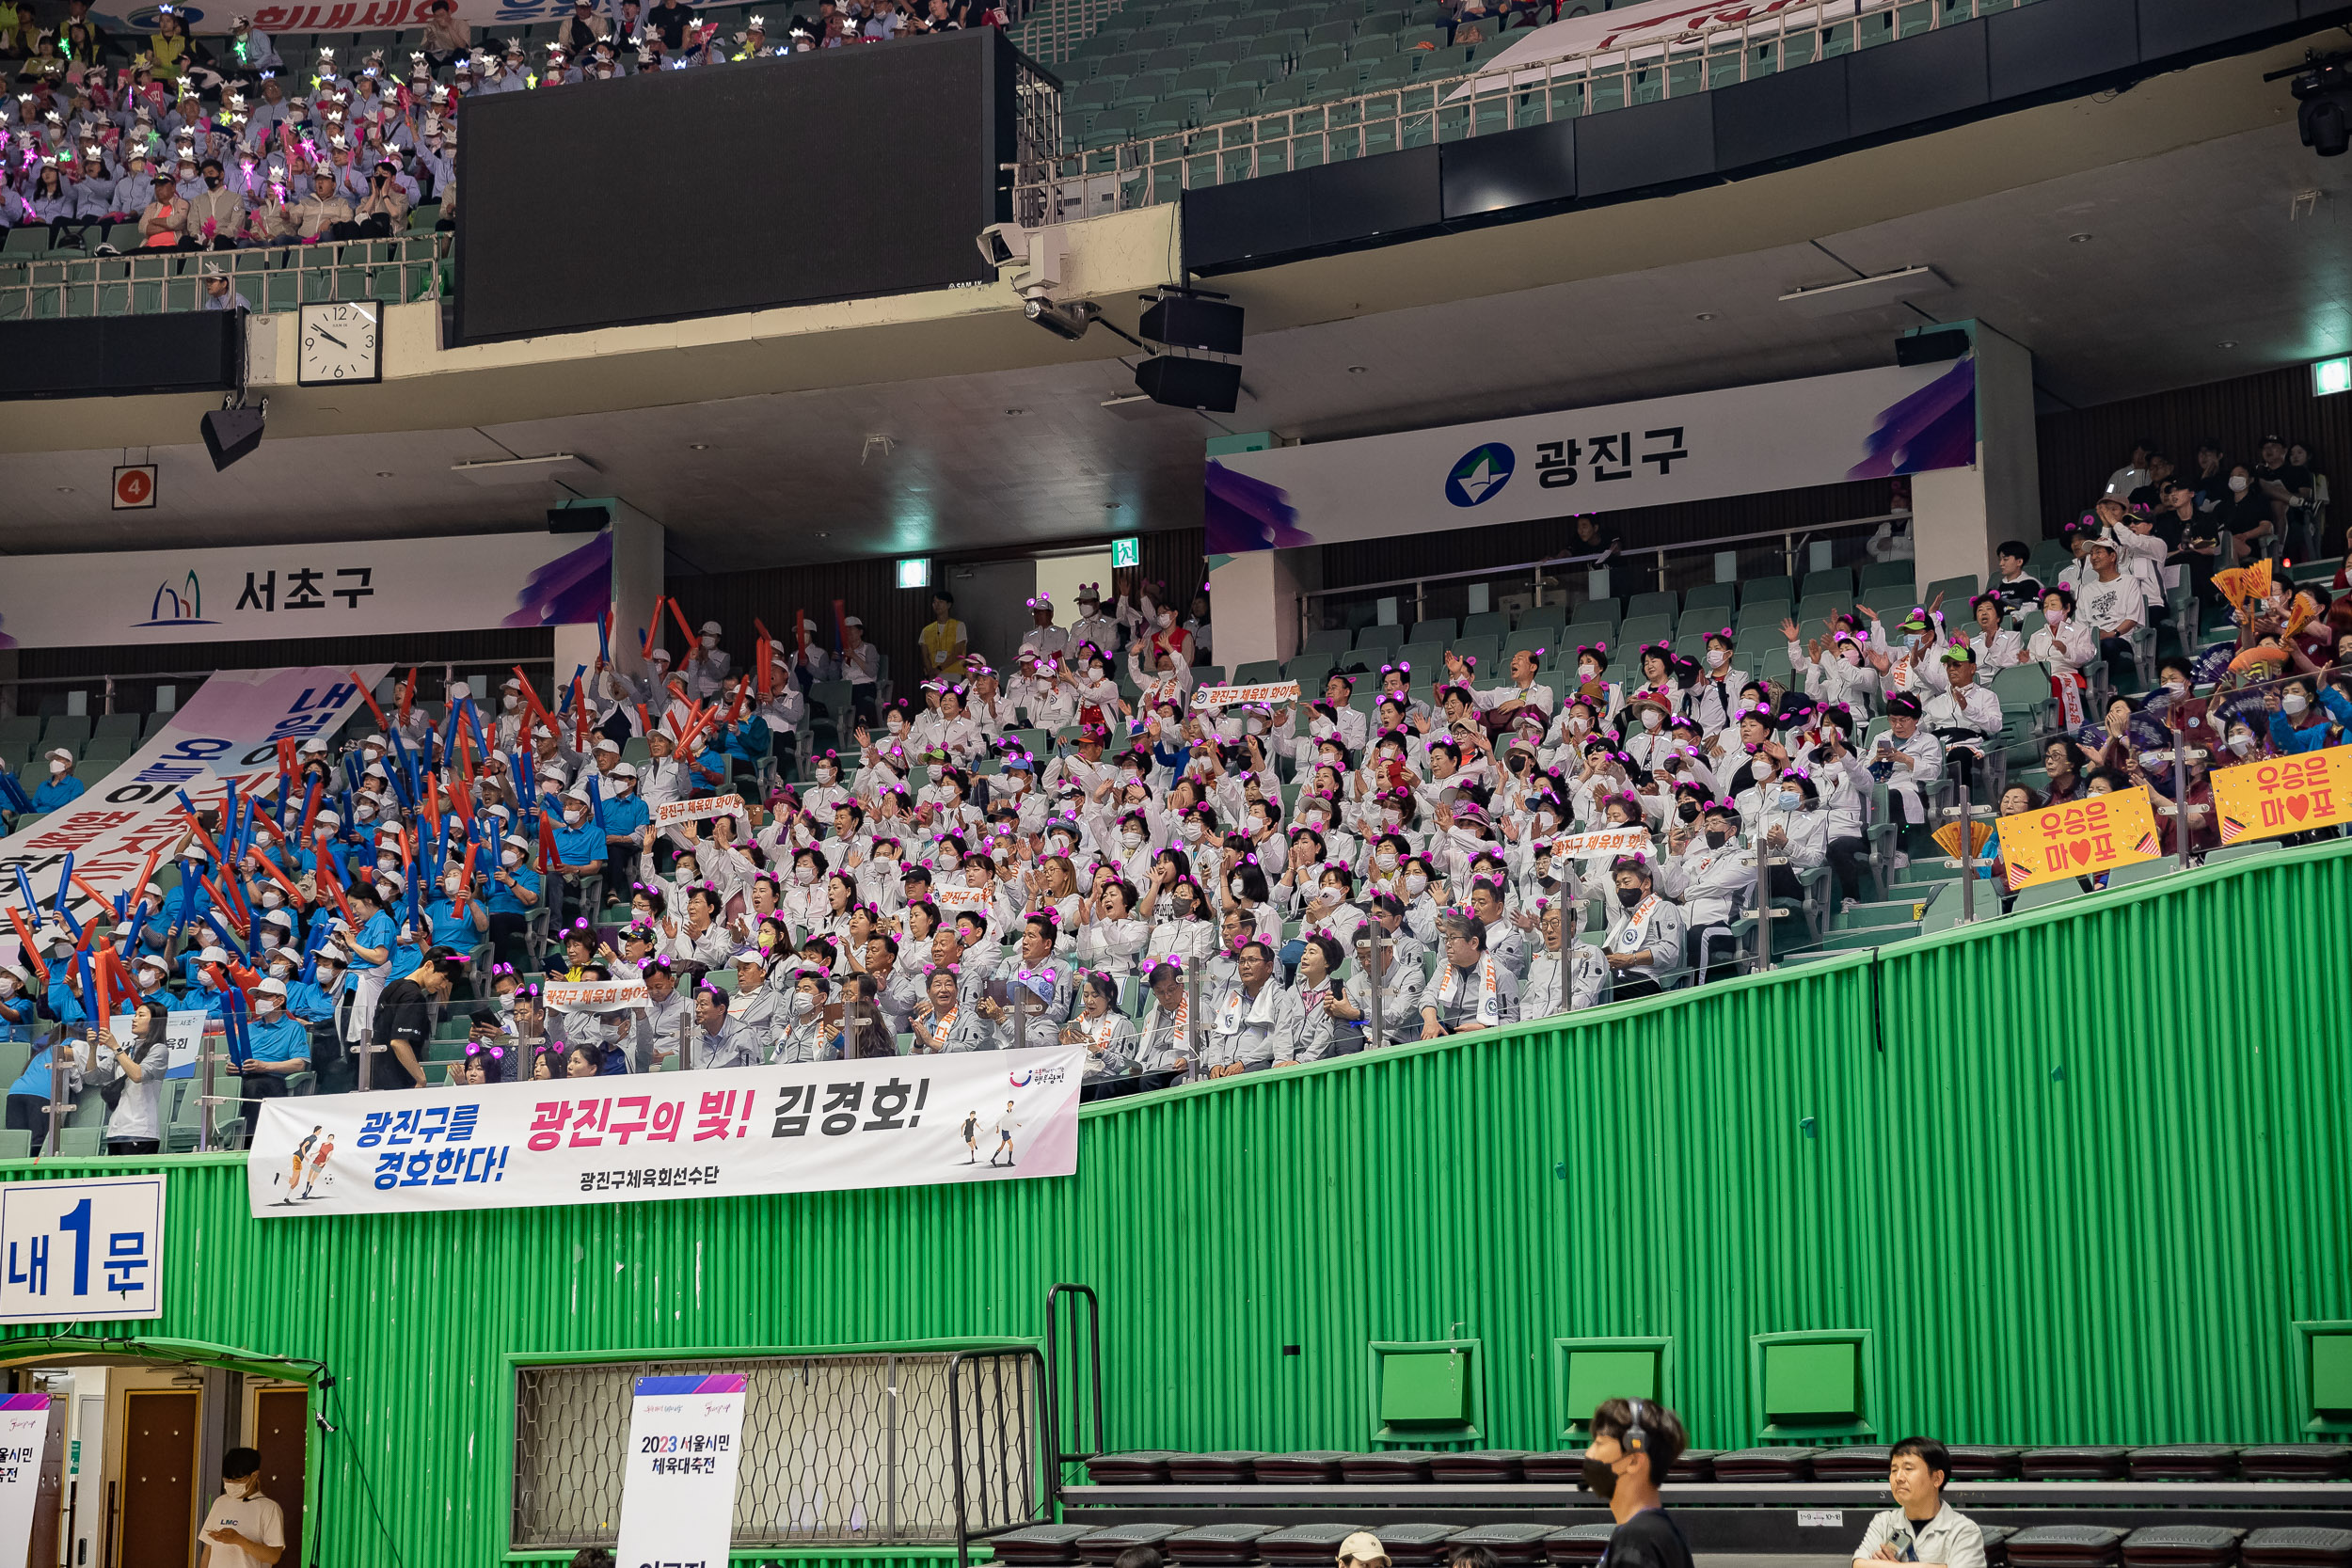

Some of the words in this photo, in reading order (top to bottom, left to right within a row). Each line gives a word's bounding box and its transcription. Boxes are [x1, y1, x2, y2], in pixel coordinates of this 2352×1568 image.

[332, 306, 347, 321] 12
[304, 337, 315, 351] 9
[365, 334, 374, 349] 3
[333, 364, 344, 378] 6
[1534, 426, 1689, 489] 광진구
[127, 478, 142, 496] 4
[234, 567, 374, 612] 서초구
[1210, 689, 1238, 705] 광진구
[1240, 687, 1269, 702] 체육회
[2256, 756, 2330, 795] 우승은
[660, 802, 686, 821] 광진구
[687, 798, 714, 814] 체육회
[2040, 801, 2110, 840] 우승은
[1585, 833, 1624, 850] 체육회
[580, 987, 618, 1005] 체육회
[527, 1095, 686, 1152] 광진구의
[692, 1089, 756, 1143] 빛!
[771, 1077, 930, 1139] 김경호!
[356, 1104, 481, 1148] 광진구를
[373, 1145, 511, 1191] 경호한다!
[580, 1165, 721, 1193] 광진구체육회선수단
[641, 1435, 678, 1454] 2023
[679, 1433, 731, 1453] 서울시민
[651, 1456, 716, 1476] 체육대축전
[220, 1518, 239, 1527] LMC
